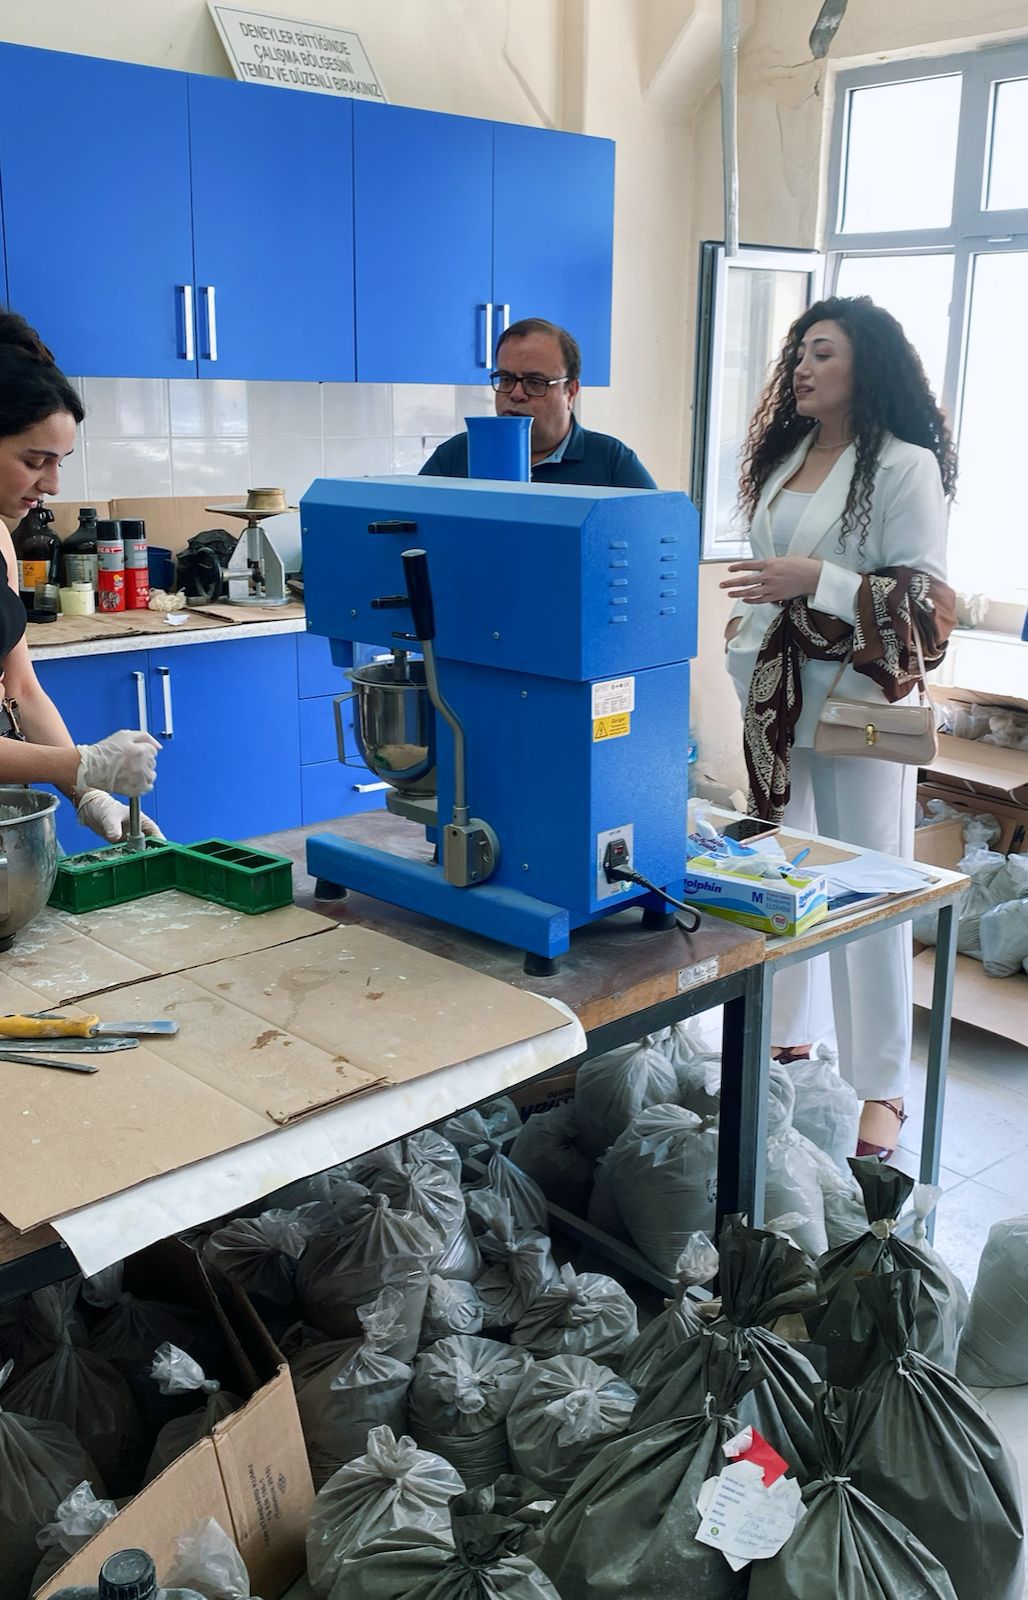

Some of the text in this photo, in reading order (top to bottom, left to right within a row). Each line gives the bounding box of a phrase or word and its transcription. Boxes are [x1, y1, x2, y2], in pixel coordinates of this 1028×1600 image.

[239, 22, 351, 55] DENEYLER BİTTİĞİNDE
[254, 44, 354, 74] ÇALIŞMA BÖLGESİNİ
[240, 60, 382, 97] TEMİZ VE DÜZENLİ BIRAKINIZ
[751, 891, 763, 904] M
